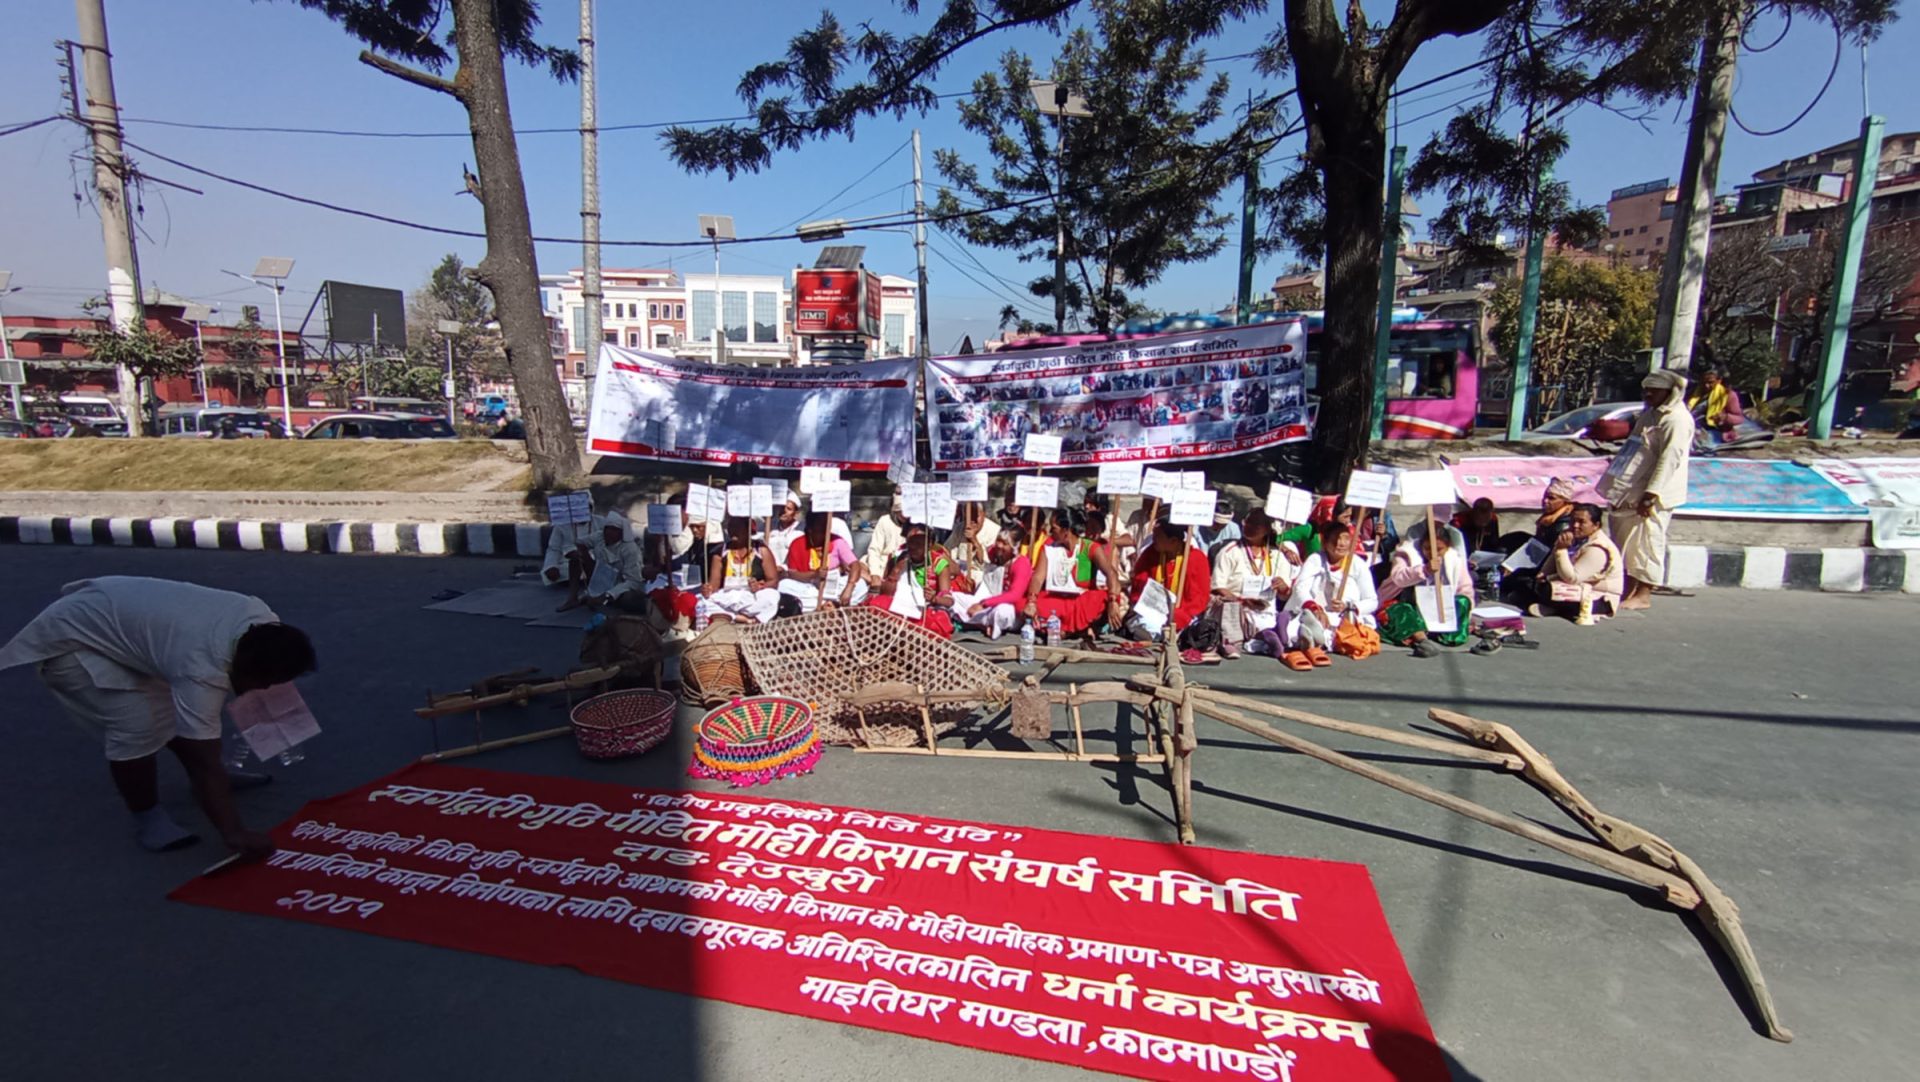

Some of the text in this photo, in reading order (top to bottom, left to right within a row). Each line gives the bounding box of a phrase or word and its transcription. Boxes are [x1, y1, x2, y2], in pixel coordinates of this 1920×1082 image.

[368, 784, 1303, 922] स्वर्गद्वारी गुठि पीडित मोही किसान संघर्ष समिति
[717, 851, 885, 894] देउखुरी
[841, 810, 922, 833] निजि
[275, 889, 385, 919] २०८१
[799, 975, 957, 1024] माइतिघर
[281, 852, 389, 880] प्राप्तिको
[375, 866, 452, 896] कानून
[438, 871, 566, 913] निर्माणका
[557, 895, 638, 924] लागि
[628, 906, 787, 951] दबावमूलक
[786, 930, 1033, 992] अनिश्चितकालिन
[1041, 971, 1138, 1010] धर्ना
[1143, 985, 1372, 1050] कार्यक्रम
[415, 838, 481, 863] निजि
[469, 849, 526, 873] गुठि
[517, 856, 626, 887] स्वर्गद्वारी
[617, 872, 732, 902] आश्रमको
[725, 883, 789, 914] मोही
[1065, 936, 1224, 980] प्रमाण-पत्र
[1224, 960, 1382, 1005] अनुसारको
